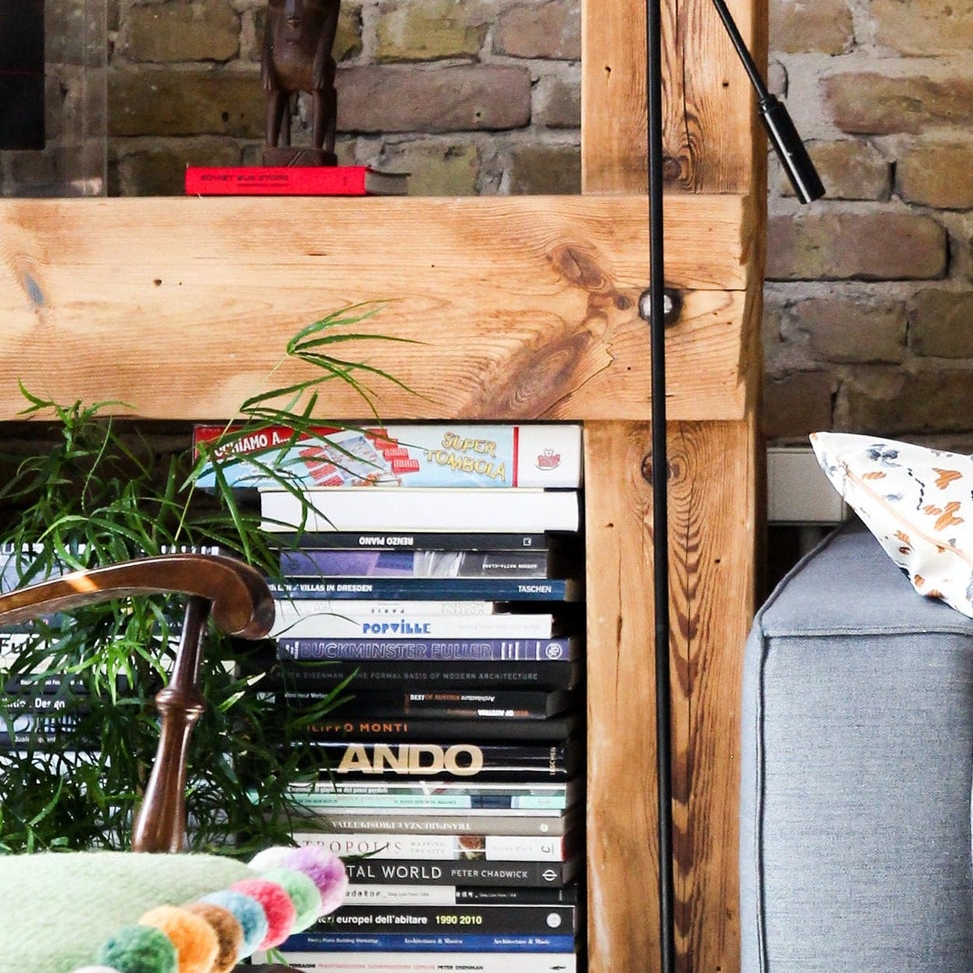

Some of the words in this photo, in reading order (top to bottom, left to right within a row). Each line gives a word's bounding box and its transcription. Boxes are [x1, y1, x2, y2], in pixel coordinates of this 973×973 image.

[441, 431, 496, 458] SUPER
[424, 449, 506, 482] TOMBOLA
[359, 536, 385, 545] PIANO
[386, 536, 414, 545] RENZO
[300, 584, 325, 592] VILLAS
[326, 584, 336, 592] IN
[337, 584, 373, 592] DRESDEN
[518, 585, 552, 593] TASCHEN
[300, 642, 428, 659] BUCKMINSTER
[431, 643, 493, 659] FULLER
[360, 723, 408, 733] MONTI
[337, 743, 484, 776] ANDO
[381, 865, 442, 879] WORLD
[451, 869, 479, 877] PETER
[481, 870, 528, 878] CHADWICK
[336, 915, 373, 925] europei
[375, 915, 428, 924] dell'abitare
[435, 915, 458, 924] 1990
[460, 915, 482, 924] 2010
